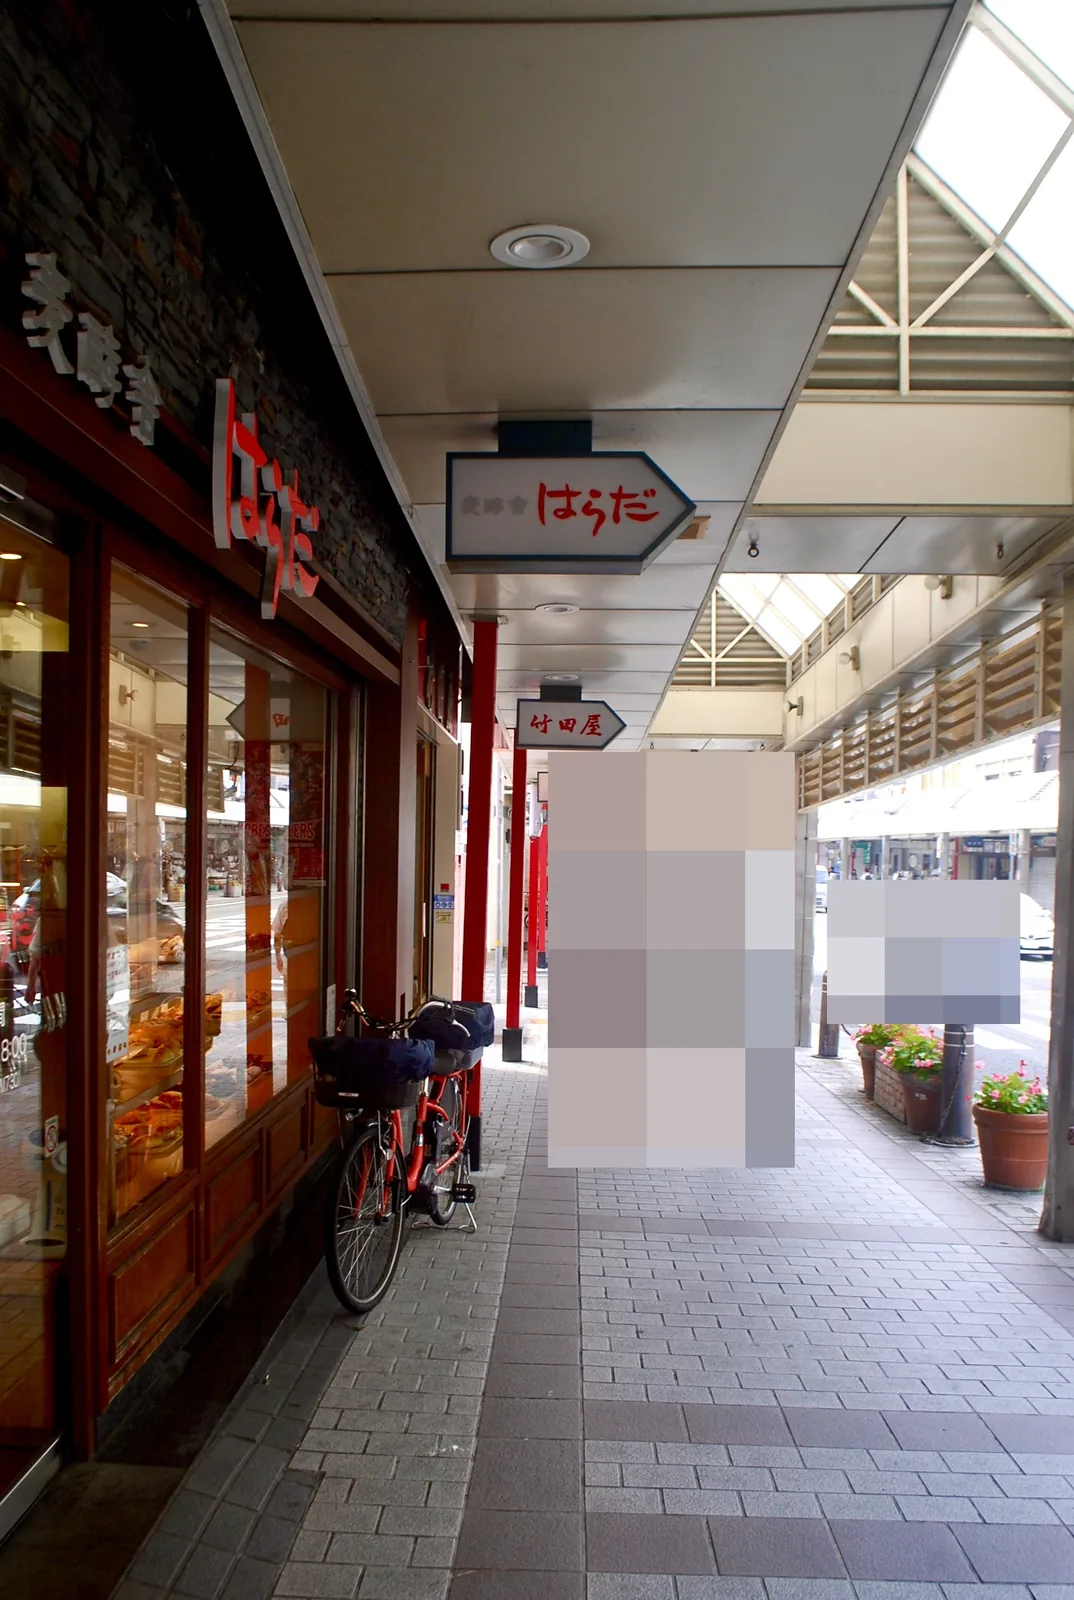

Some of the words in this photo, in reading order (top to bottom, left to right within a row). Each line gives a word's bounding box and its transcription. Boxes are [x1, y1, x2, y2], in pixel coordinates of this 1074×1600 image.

[212, 378, 319, 619] はらだ
[537, 482, 660, 538] はらだ
[529, 713, 603, 737] 竹田屋
